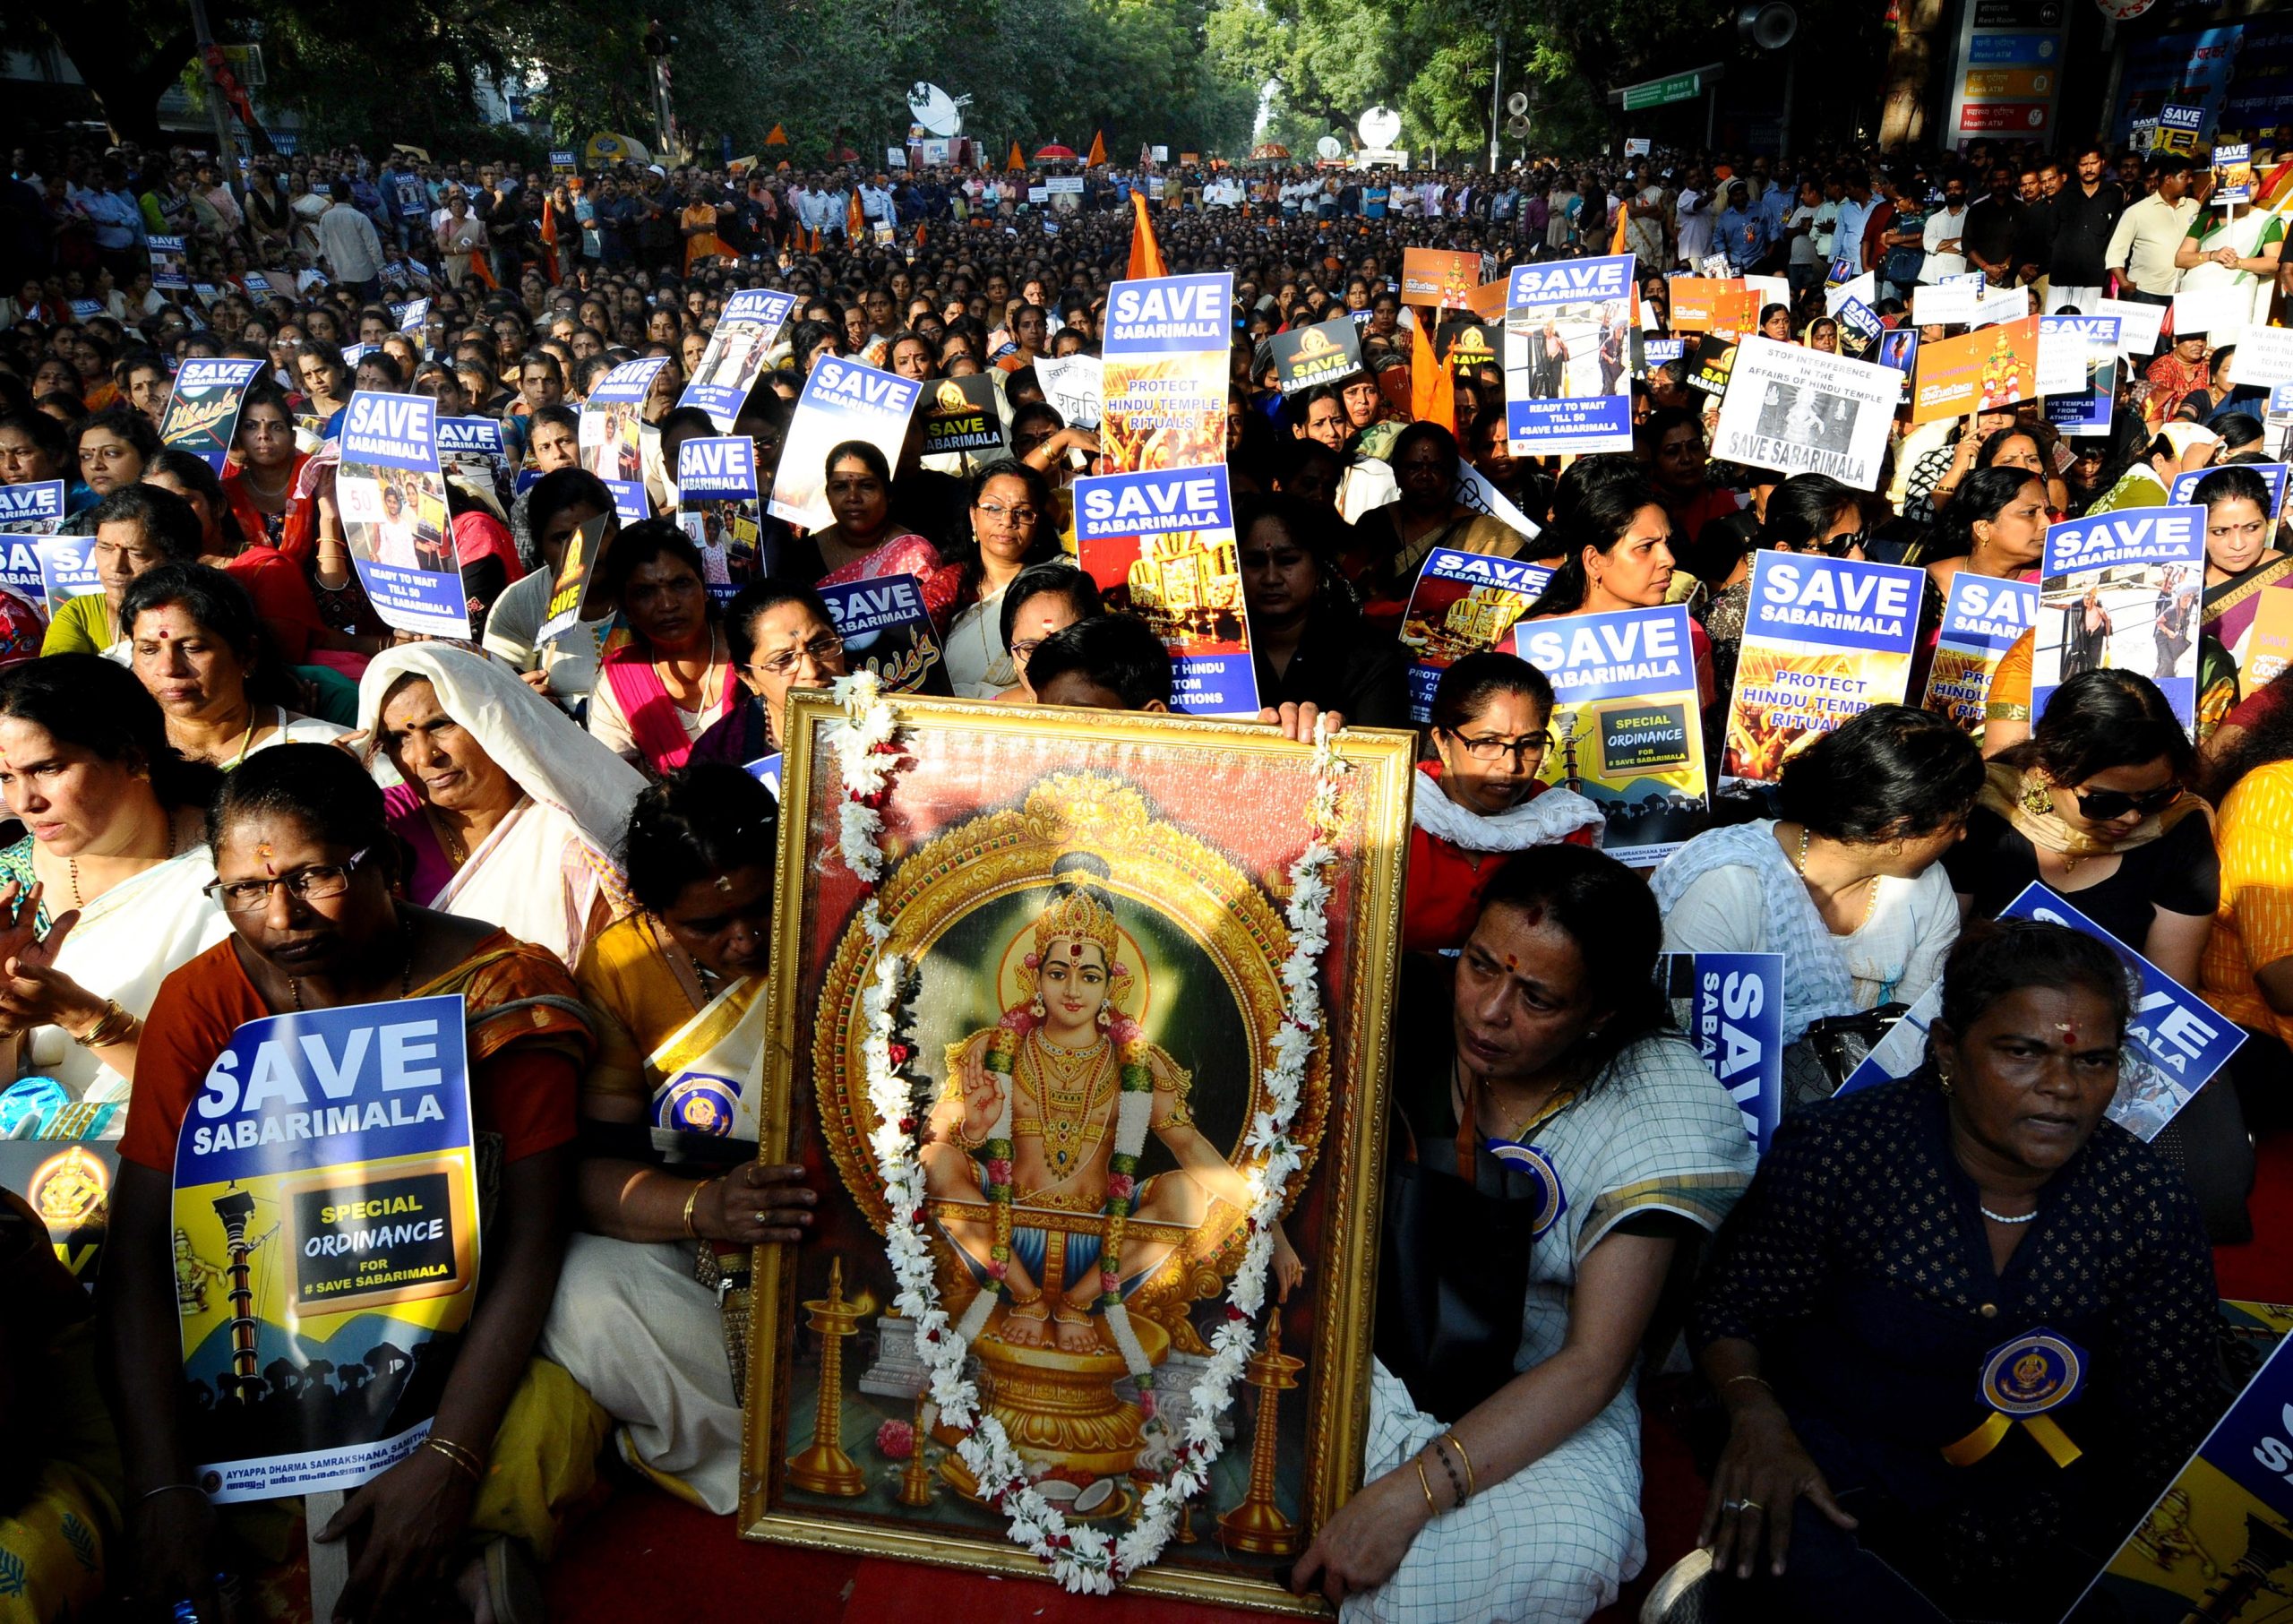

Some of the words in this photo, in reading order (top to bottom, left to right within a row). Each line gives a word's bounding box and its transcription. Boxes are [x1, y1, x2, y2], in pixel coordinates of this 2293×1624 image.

[2163, 108, 2201, 122] SAVE
[551, 153, 571, 161] SAVE
[2215, 143, 2248, 158] SAVE
[148, 236, 182, 246] SAVE
[1702, 253, 1725, 267] SAVE
[1517, 263, 1624, 294] SAVE
[1114, 284, 1223, 324] SAVE
[1516, 285, 1621, 304] SABARIMALA
[404, 301, 426, 320] AVE
[729, 296, 788, 315] SAVE
[1846, 298, 1882, 332] SAVE
[726, 311, 778, 322] SABARIMALA
[2040, 319, 2117, 334] SAVE
[1113, 322, 1221, 339] SABARIMALA
[1644, 340, 1681, 355] SAVE
[2257, 345, 2279, 355] WAIT
[183, 363, 256, 380] SAVE
[606, 360, 662, 382] SAVE
[1292, 352, 1349, 378] SAVE
[1767, 348, 1794, 360] STOP
[1796, 356, 1873, 380] INTERFERENCE
[1800, 366, 1812, 375] IN
[1814, 371, 1834, 382] THE
[2272, 360, 2293, 369] ENTE
[180, 377, 245, 388] SABARIMALA
[1129, 380, 1198, 393] PROTECT
[1282, 360, 1362, 393] SABARIMALA
[1748, 366, 1791, 382] AFFAIRS
[1792, 376, 1807, 385] OF
[1809, 381, 1842, 393] HINDU
[1844, 389, 1884, 404] TEMPLE
[817, 362, 912, 413] SAVE
[812, 386, 905, 417] SABARIMALA
[1108, 400, 1154, 412] HINDU
[1160, 398, 1220, 411] TEMPLE
[1529, 403, 1561, 414] READY
[1564, 402, 1578, 412] TO
[1580, 400, 1607, 411] WAIT
[350, 397, 428, 443] SAVE
[929, 417, 985, 437] SAVE
[1130, 417, 1194, 431] RITUALS
[1550, 413, 1571, 423] TILL
[1573, 413, 1586, 422] 50
[439, 425, 496, 443] AVE
[1520, 424, 1550, 436] #SAVE
[1552, 422, 1618, 434] SABARIMALA
[347, 435, 430, 461] SABARIMALA
[438, 440, 498, 451] BARIMALA
[926, 431, 1001, 451] ABARIMALA
[681, 443, 747, 477] SAVE
[1728, 432, 1767, 462] SAVE
[1769, 441, 1865, 483] SABARIMALA
[681, 477, 749, 492] SABARIMALA
[0, 488, 56, 510] AVE
[351, 493, 372, 511] 50
[1085, 478, 1219, 520] SAVE
[0, 506, 56, 520] ARIMALA
[1086, 511, 1221, 535] SABARIMALA
[2053, 517, 2192, 558] SAVE
[52, 546, 97, 571] SA
[2053, 544, 2190, 571] SABARIMALA
[370, 567, 393, 581] READY
[394, 571, 411, 585] TO
[413, 573, 437, 588] WAIT
[1432, 567, 1544, 595] SABARIMALA
[1436, 554, 1551, 588] SAVE
[388, 583, 408, 597] TILL
[408, 587, 420, 598] 50
[714, 589, 723, 597] TO
[724, 589, 741, 598] WA
[1763, 564, 1911, 617] SAVE
[392, 595, 454, 615] SABARIMALA
[548, 583, 581, 621] SAVE
[824, 583, 917, 623] SAVE
[1957, 584, 2041, 627] SAV
[837, 607, 921, 634] ABARIMALA
[1760, 605, 1903, 637] SABARIMALA
[1954, 616, 2027, 640] SABARI
[1529, 618, 1680, 672] SAVE
[2259, 633, 2289, 648] SAVE
[1182, 662, 1225, 675] HINDU
[1550, 659, 1682, 689] ABARIMALA
[1172, 679, 1202, 691] TOM
[1775, 670, 1868, 694] PROTECT
[1170, 692, 1224, 705] DITIONS
[1743, 688, 1808, 709] HINDU
[1815, 696, 1876, 716] TEMP
[1934, 683, 1988, 702] HINDU
[1616, 715, 1671, 729] SPECIAL
[1771, 713, 1840, 733] RITUA
[1607, 728, 1684, 747] ORDINANCE
[1615, 758, 1636, 766] SAVE
[1636, 753, 1686, 765] SABARIMALA
[1638, 748, 1654, 756] FOR
[1615, 848, 1659, 857] SAMRAKSHANA
[197, 1018, 442, 1119] SAVE
[1721, 971, 1764, 1151] SAV
[193, 1094, 445, 1156] SABARIMALA
[321, 1195, 423, 1224] SPECIAL
[304, 1218, 443, 1258] ORDINANCE
[360, 1259, 388, 1273] FOR
[305, 1284, 313, 1295] #
[316, 1279, 352, 1293] SAVE
[356, 1263, 448, 1288] SABARIMALA
[227, 1466, 267, 1480] AYYAPPA
[269, 1461, 308, 1474] DHARMA
[310, 1448, 388, 1469] SAMRAKSHANA
[391, 1429, 430, 1454] SAMITHI
